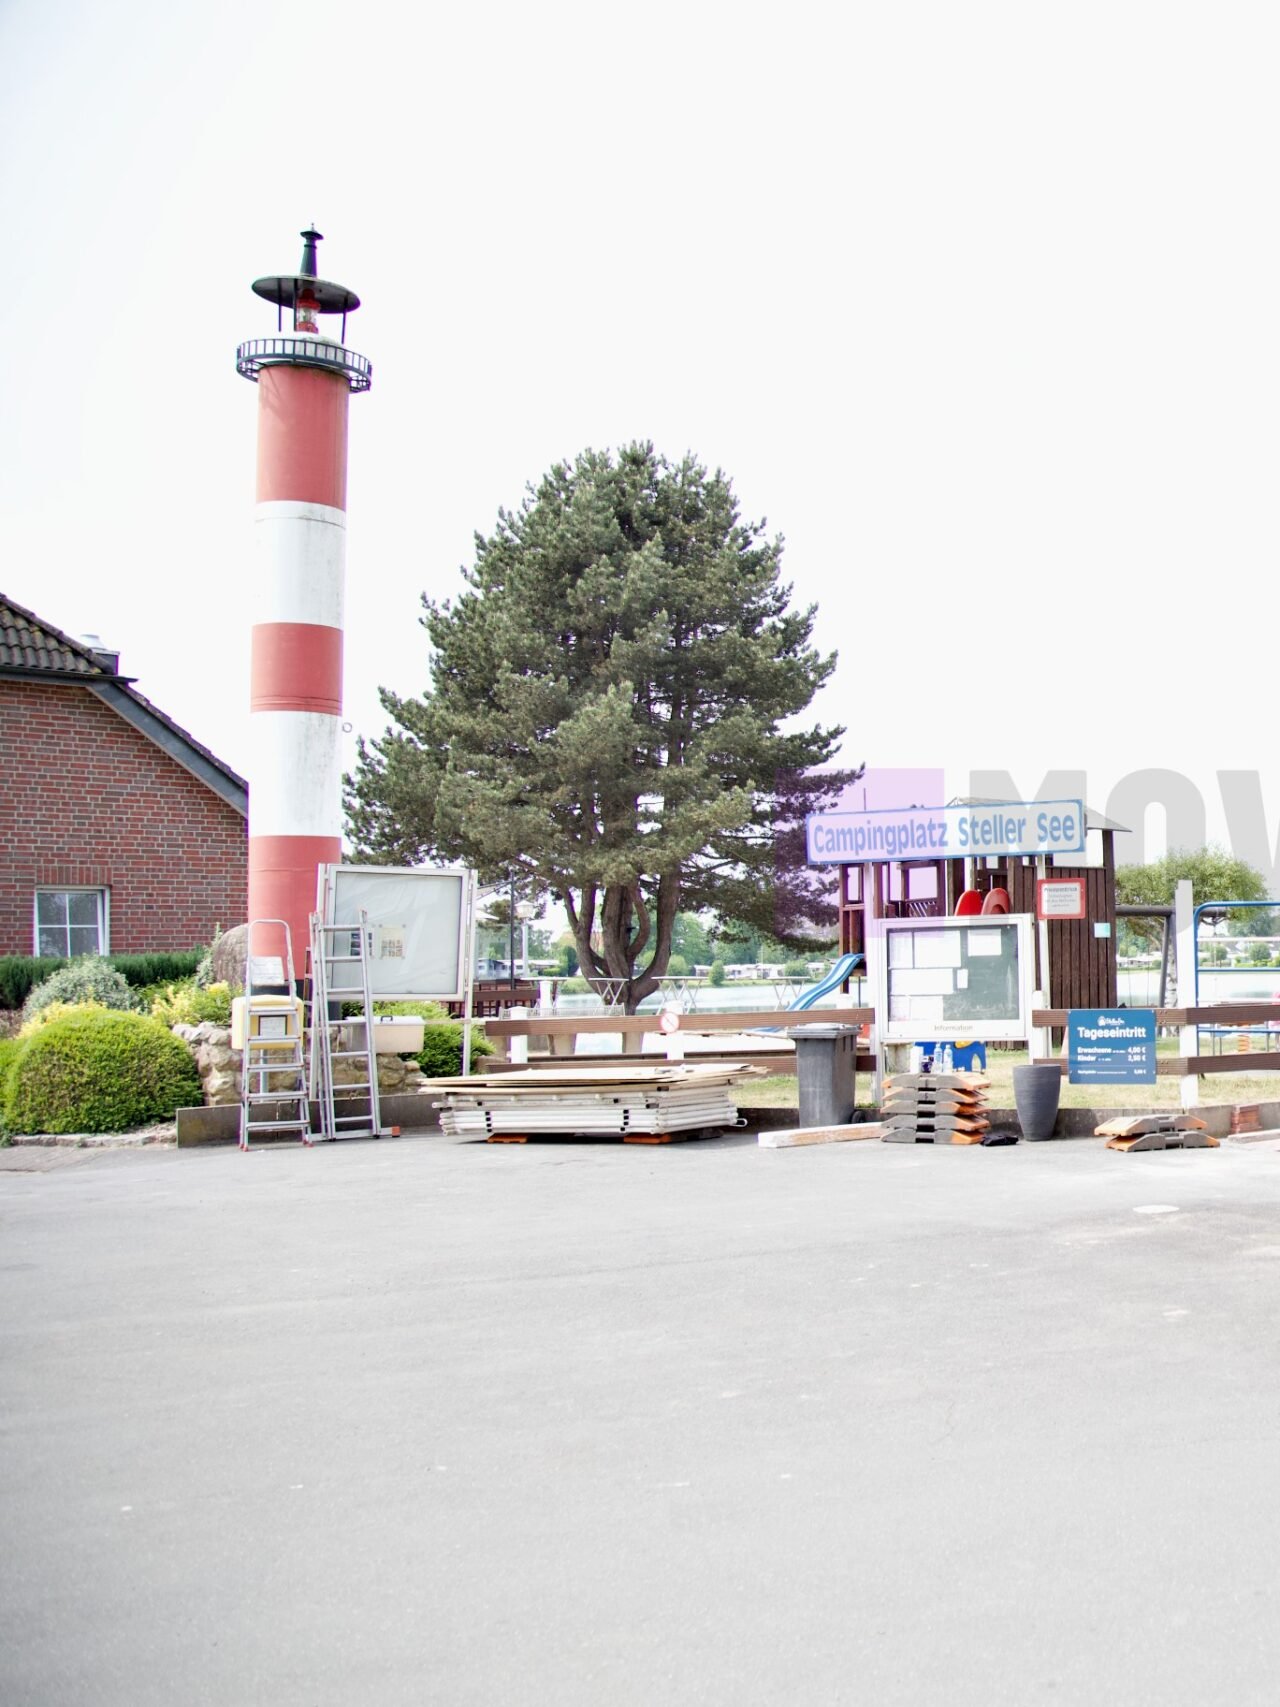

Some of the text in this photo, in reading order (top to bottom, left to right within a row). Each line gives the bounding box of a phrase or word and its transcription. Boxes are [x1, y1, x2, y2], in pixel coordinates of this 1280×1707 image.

[814, 812, 1075, 855] Campingplatz Steller See
[1077, 1026, 1146, 1040] Tageseintritt
